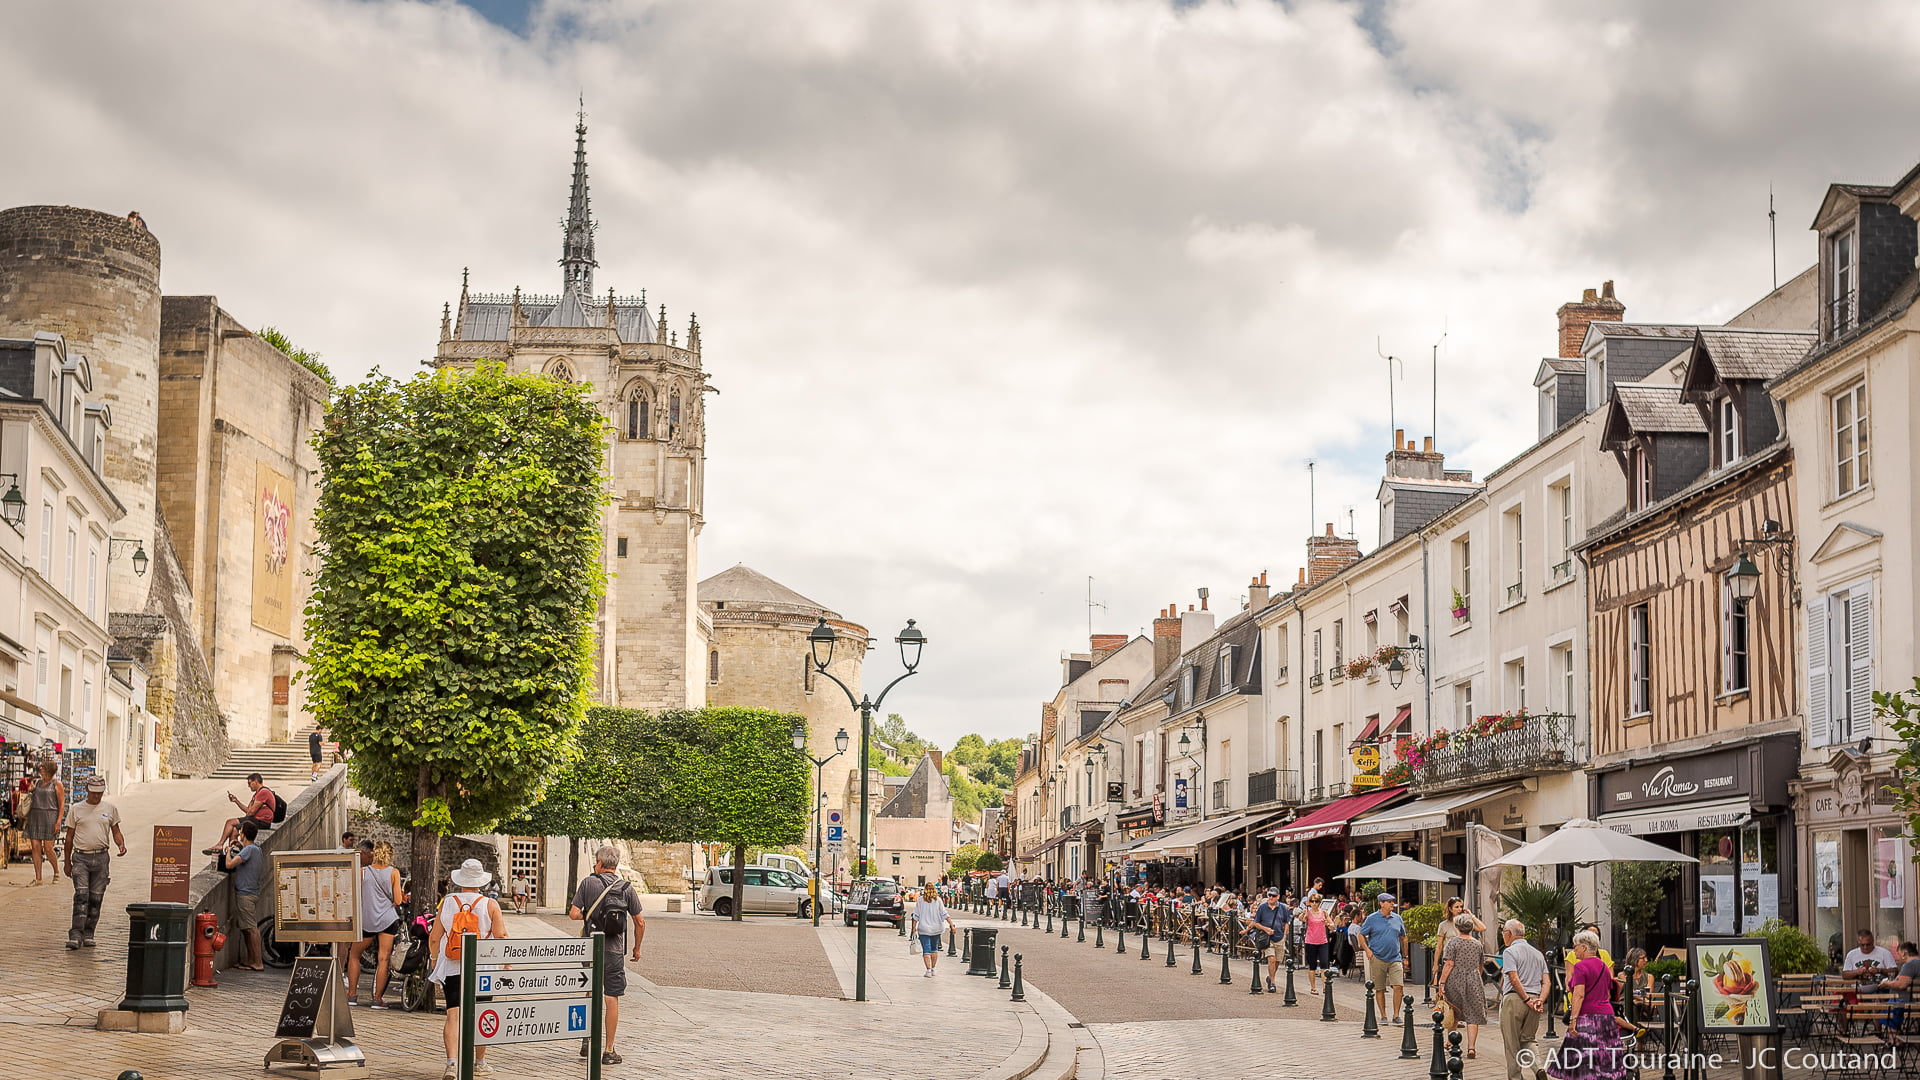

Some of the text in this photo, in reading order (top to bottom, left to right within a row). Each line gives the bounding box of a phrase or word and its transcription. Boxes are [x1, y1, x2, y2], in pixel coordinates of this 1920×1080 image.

[1357, 758, 1377, 767] Leffe
[1659, 774, 1699, 799] Roma
[1703, 776, 1733, 789] RESTAURANT
[1616, 791, 1633, 801] PIZZERIA
[1153, 794, 1163, 821] TABAC
[829, 827, 837, 838] P
[1648, 819, 1679, 832] VIA ROMA
[503, 945, 527, 958] Place
[528, 945, 557, 957] Michel
[558, 941, 586, 956] DEBRÉ
[480, 977, 490, 991] P
[518, 975, 549, 988] Gratuit
[554, 975, 567, 987] 50
[506, 1006, 536, 1020] ZONE
[506, 1021, 561, 1037] PIÉTONNE
